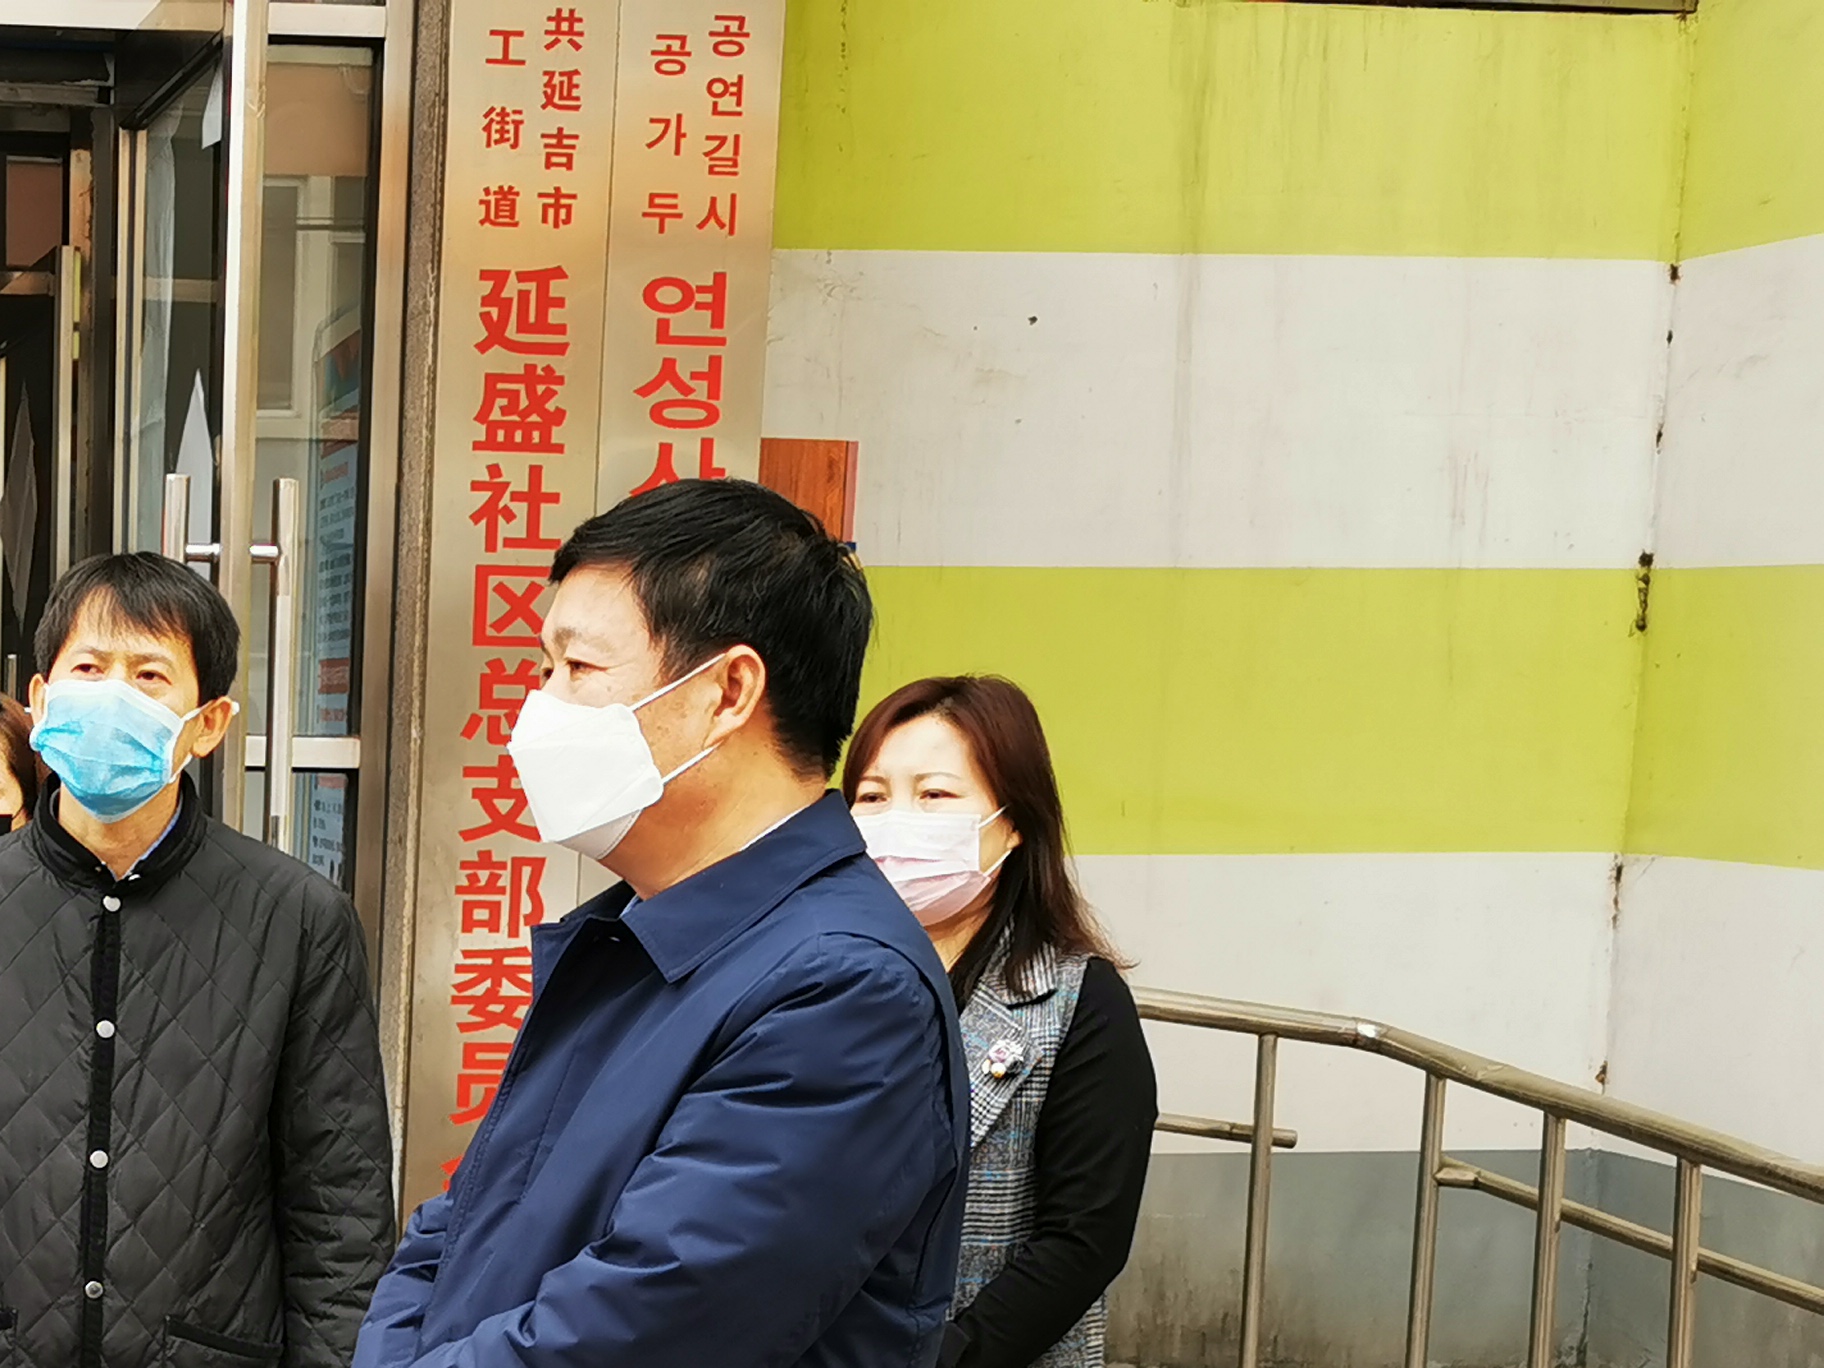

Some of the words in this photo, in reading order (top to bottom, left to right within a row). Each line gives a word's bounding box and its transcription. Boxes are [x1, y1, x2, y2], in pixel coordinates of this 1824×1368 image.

[478, 29, 526, 229] 工街道
[537, 8, 585, 230] 共延吉市
[641, 34, 693, 234] 공가두
[696, 15, 751, 237] 공연길시
[440, 265, 571, 1192] 延盛社区总支部委员
